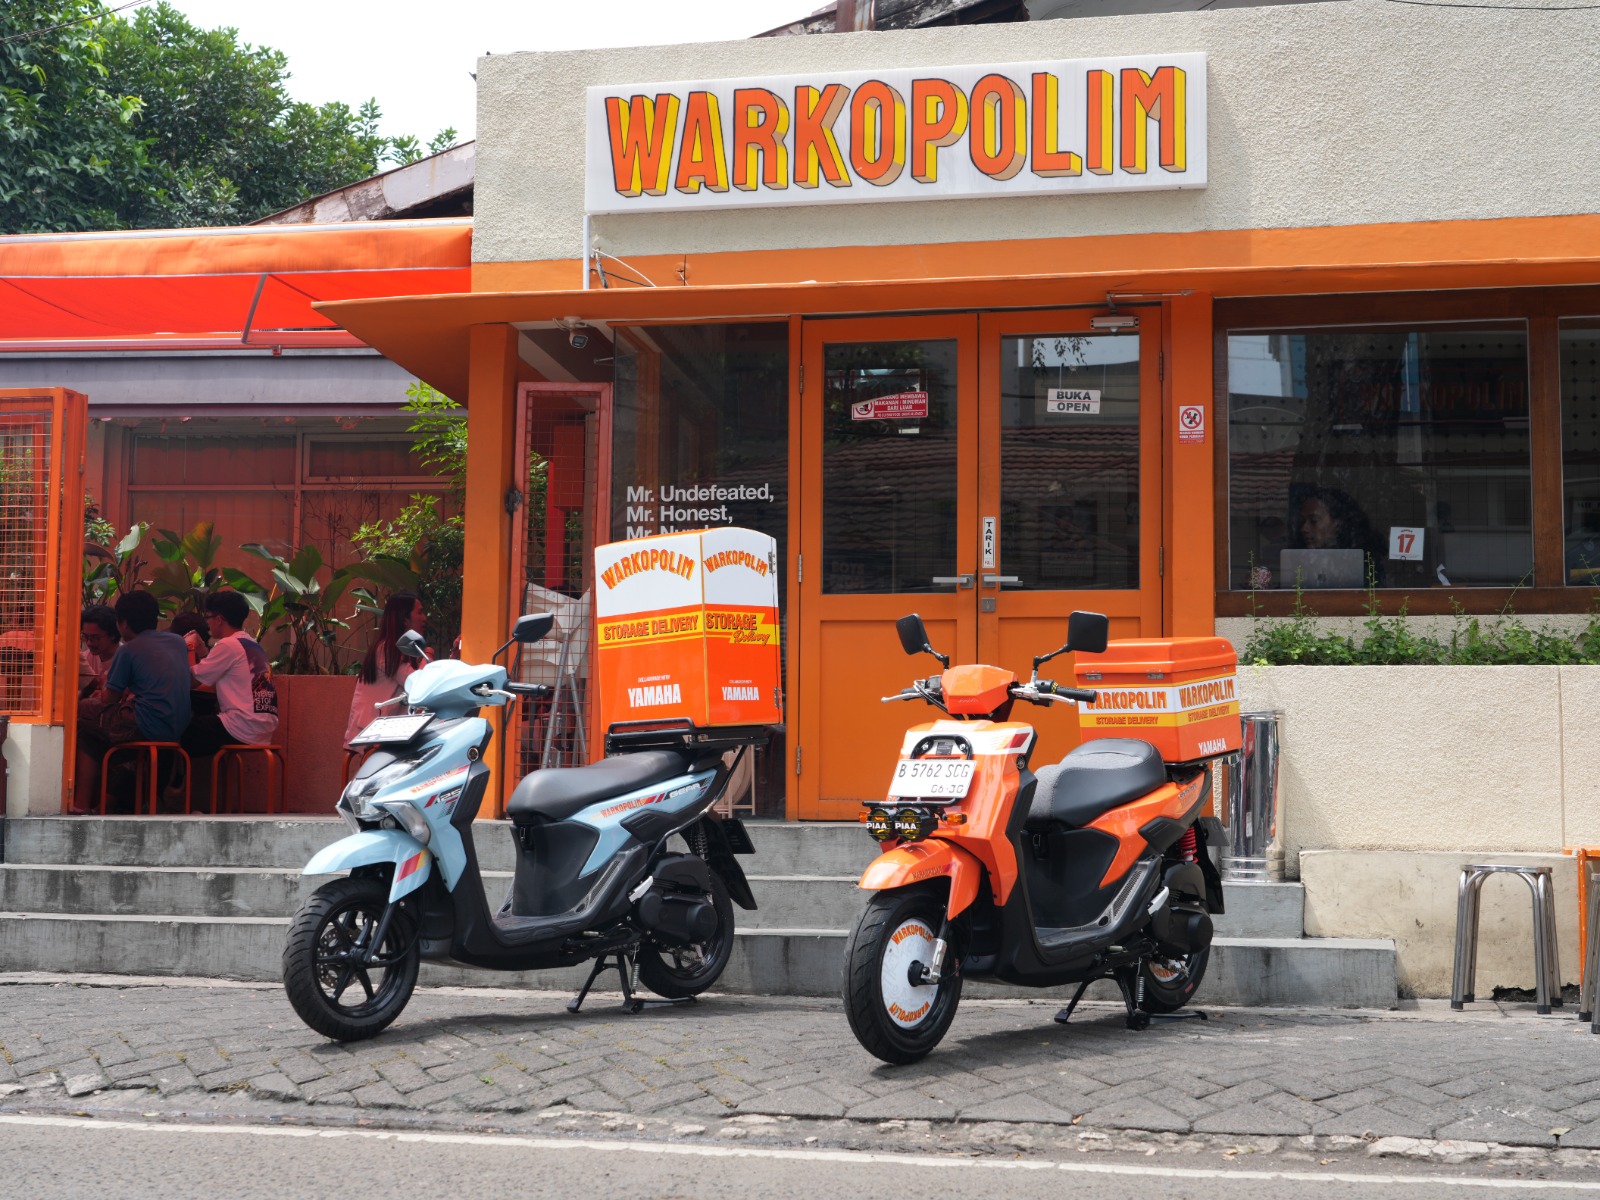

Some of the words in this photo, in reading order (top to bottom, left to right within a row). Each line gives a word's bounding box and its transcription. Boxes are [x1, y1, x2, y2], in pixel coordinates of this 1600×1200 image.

[604, 66, 1188, 197] WARKOPOLIM
[1056, 391, 1091, 400] BUKA
[1359, 380, 1525, 411] WAKOPOLIM
[1057, 402, 1090, 412] OPEN
[626, 485, 654, 502] Mr.
[660, 483, 774, 503] Undefeated,
[626, 506, 654, 522] Mr.
[660, 504, 733, 524] Honest,
[985, 521, 993, 555] TARIK
[1397, 533, 1416, 554] 17
[601, 549, 695, 590] WARKOPOLIM
[704, 550, 768, 577] WARKOPOLIM
[603, 621, 650, 640] STORAGE
[651, 615, 699, 635] DELIVERY
[705, 612, 757, 630] STORAGE
[733, 629, 770, 646] Delivery
[627, 683, 682, 708] YAMAHA
[721, 686, 760, 701] YAMAHA
[1179, 679, 1235, 708] WARKOPOLIM
[1095, 716, 1126, 725] STORAGE
[1127, 716, 1159, 725] DELIVERY
[1187, 709, 1208, 722] STORAGE
[1208, 704, 1230, 718] DELIVERY
[1198, 738, 1227, 756] YAMAHA
[898, 763, 907, 778] B
[911, 763, 942, 778] 5762
[945, 763, 970, 778] SCG
[669, 783, 701, 798] GEAR
[600, 798, 642, 818] WARKOPOLIM
[895, 822, 917, 830] PIAA
[891, 924, 933, 945] WARKOPOLIM
[889, 1001, 930, 1022] WARKOPOLIM
